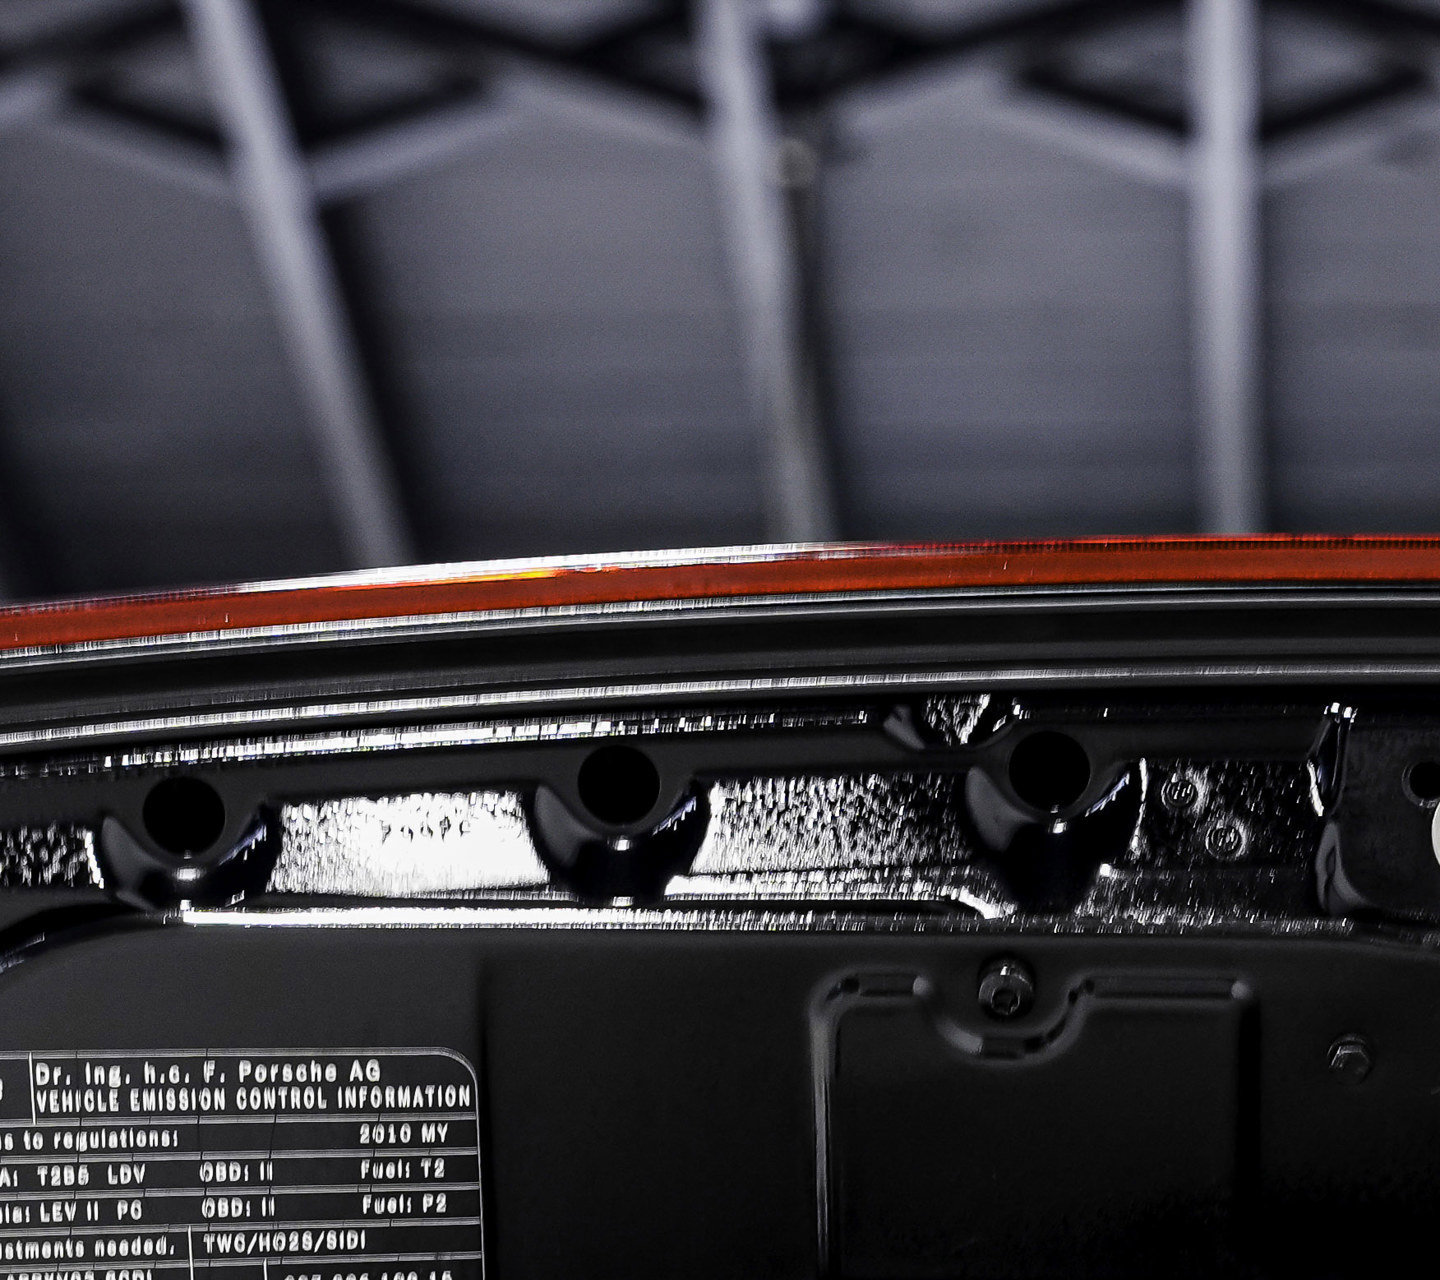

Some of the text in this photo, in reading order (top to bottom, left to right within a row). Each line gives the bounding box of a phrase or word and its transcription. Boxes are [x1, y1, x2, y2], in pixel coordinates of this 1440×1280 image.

[35, 1061, 71, 1086] Dr.
[85, 1061, 130, 1088] Ing.
[203, 1059, 226, 1083] F.
[238, 1059, 337, 1083] Porsche
[349, 1058, 381, 1082] AG
[36, 1084, 471, 1113] VEHICLE EMISSION CONTROL INFORMATION
[23, 1129, 44, 1151] to
[53, 1127, 179, 1151] regulations:
[360, 1122, 449, 1144] 2010 MY
[107, 1162, 146, 1185] LDV
[199, 1160, 273, 1182] OBD: II
[361, 1157, 445, 1180] Fuel: T2
[40, 1201, 77, 1223] LEV
[86, 1200, 99, 1221] II
[201, 1196, 275, 1218] OBD: II
[362, 1192, 447, 1215] Fuel: P2
[94, 1235, 175, 1257] needed.
